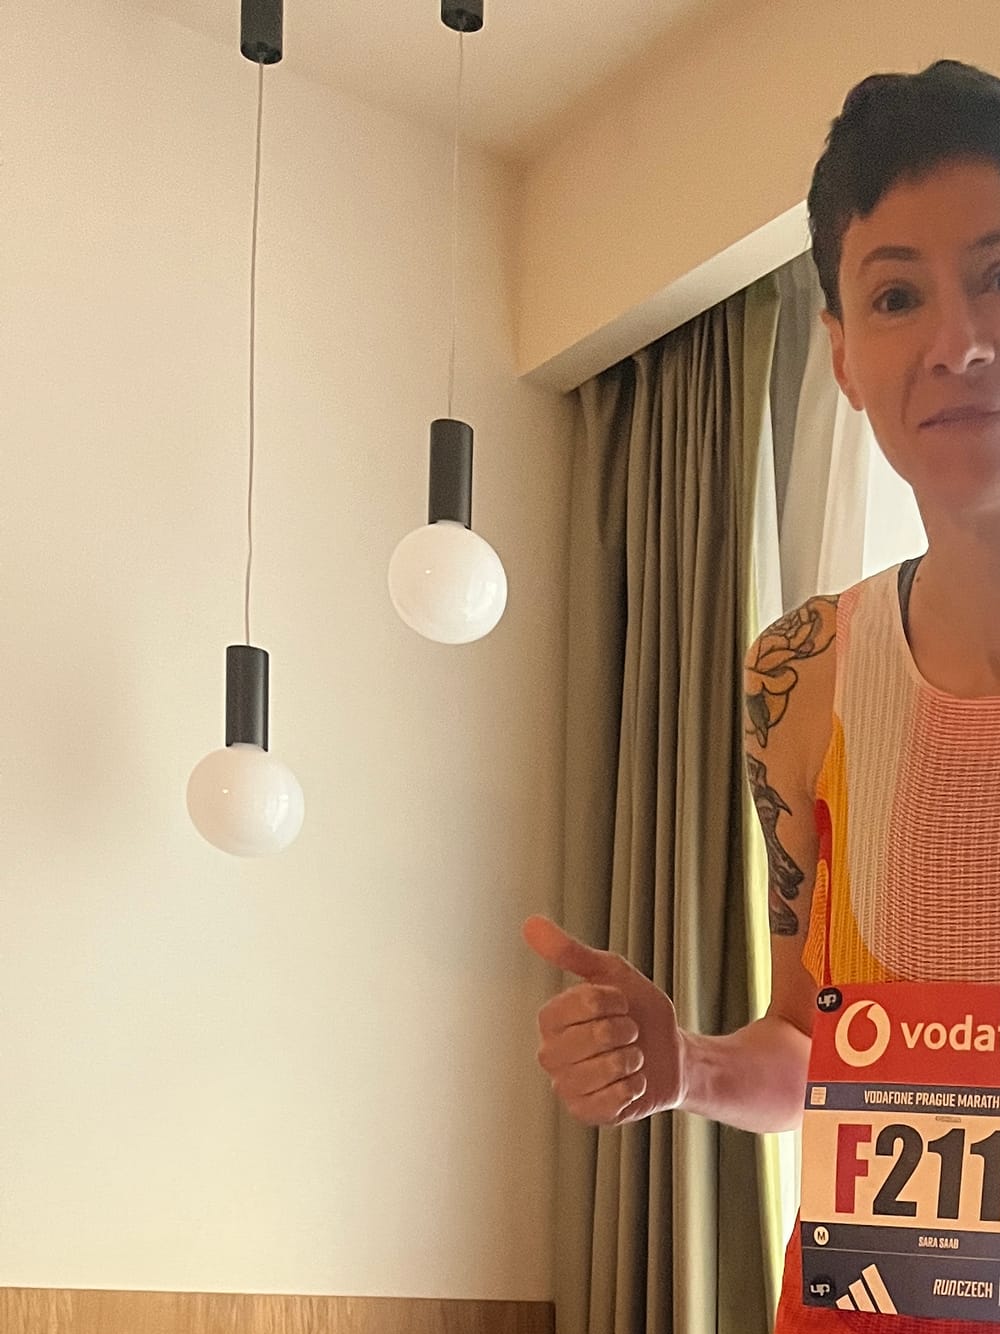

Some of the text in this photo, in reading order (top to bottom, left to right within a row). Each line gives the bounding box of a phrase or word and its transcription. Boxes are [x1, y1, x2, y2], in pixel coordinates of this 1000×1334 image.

[864, 1090, 914, 1105] VODAFONE
[916, 1092, 955, 1107] PRAGUE
[918, 1236, 959, 1250] SARA SAAB
